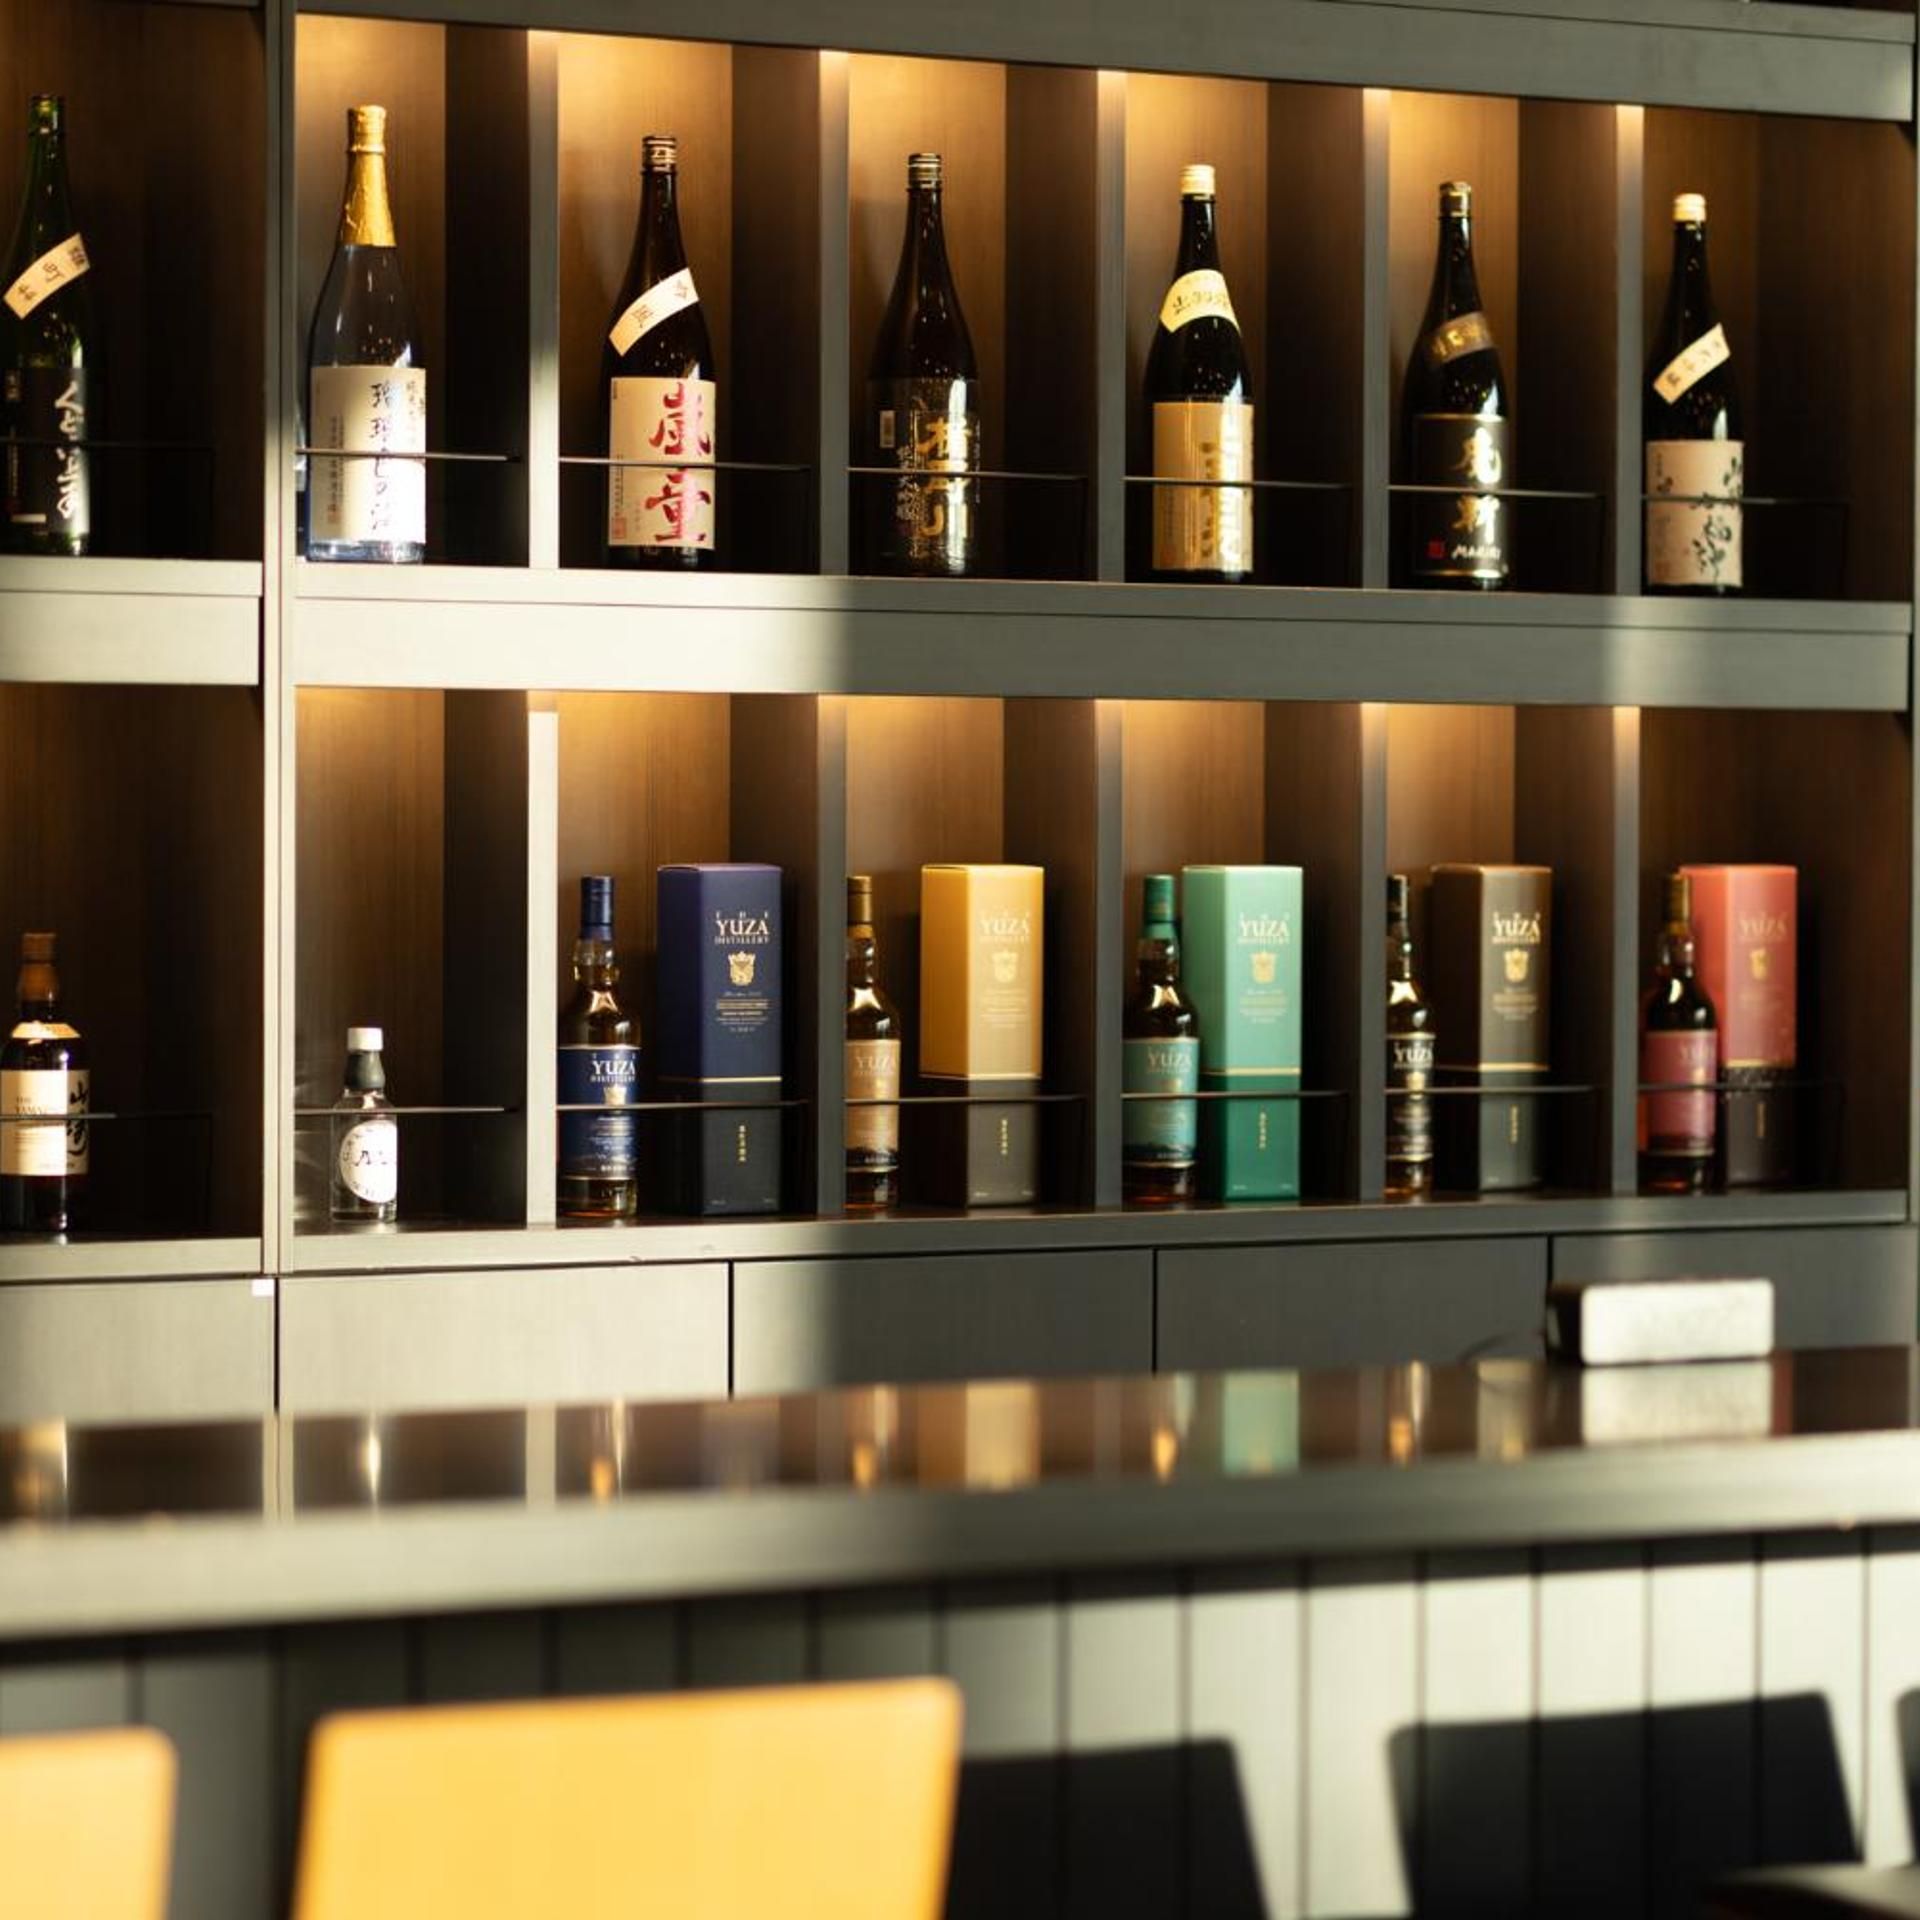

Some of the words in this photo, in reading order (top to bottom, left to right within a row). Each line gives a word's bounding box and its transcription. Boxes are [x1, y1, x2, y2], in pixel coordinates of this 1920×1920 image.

[716, 920, 769, 936] YUZA
[980, 919, 1030, 936] YUZA
[1239, 919, 1290, 936] YUZA
[1493, 919, 1541, 936] YUZA
[1740, 918, 1787, 936] YUZA
[1147, 1051, 1193, 1066] YUZA
[1394, 1048, 1434, 1062] YUZA
[592, 1060, 636, 1074] YUZA
